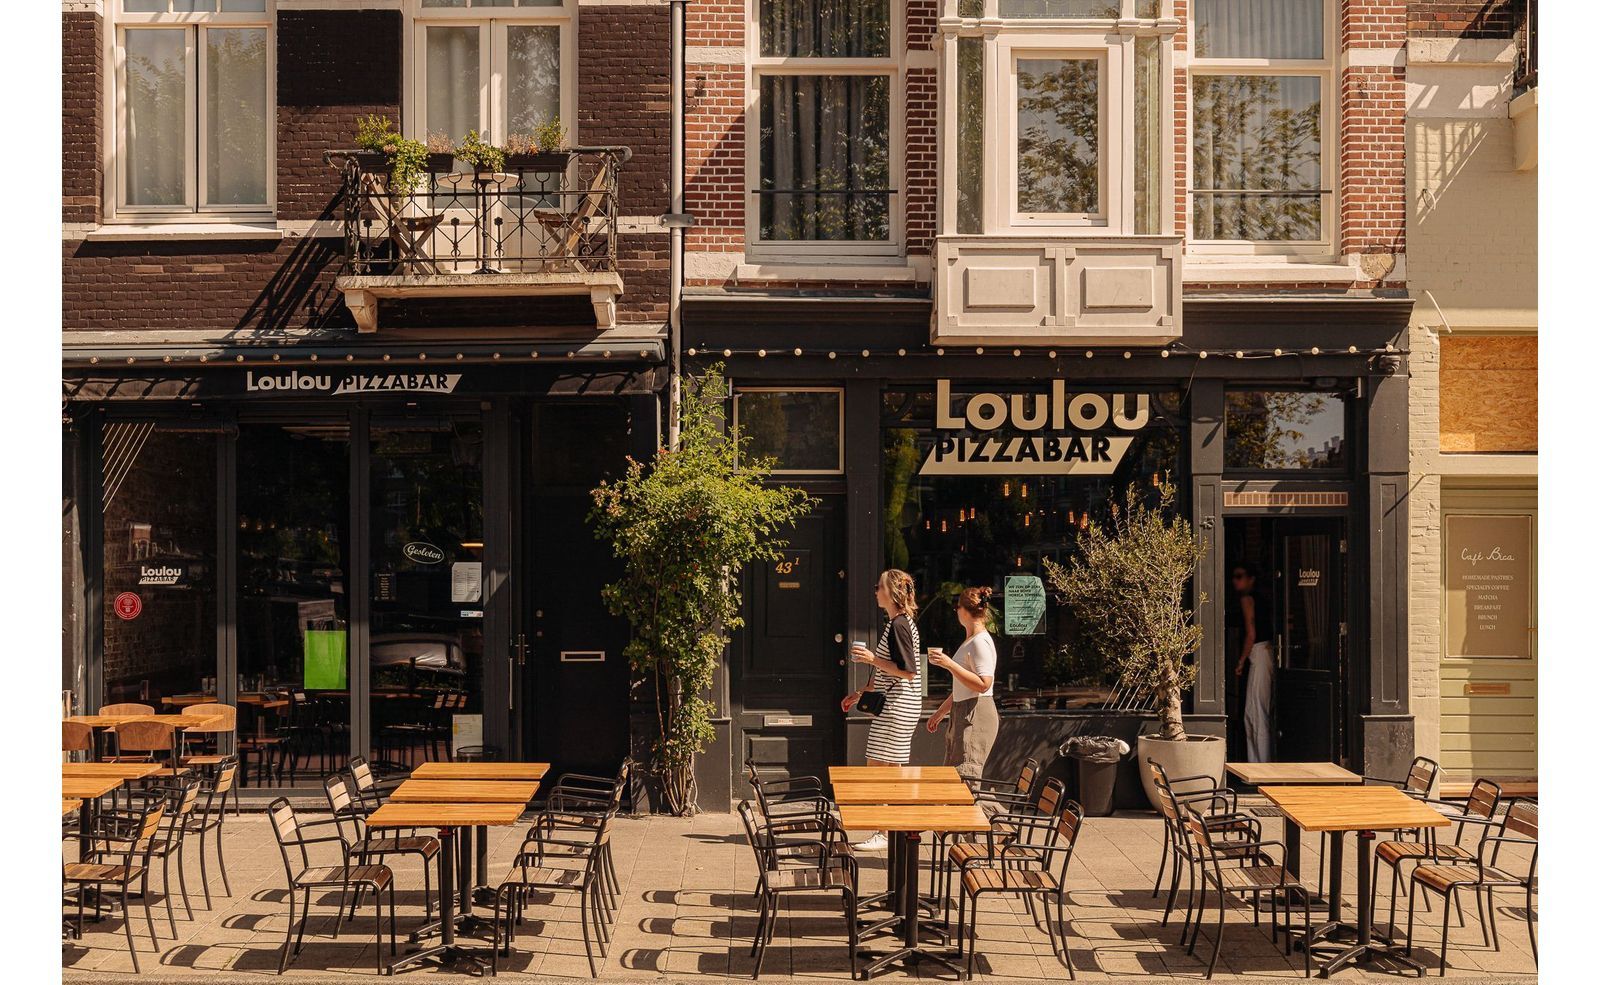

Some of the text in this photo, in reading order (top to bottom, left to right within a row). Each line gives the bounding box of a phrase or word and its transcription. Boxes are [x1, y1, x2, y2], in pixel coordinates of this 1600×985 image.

[247, 371, 449, 391] Loulou PIZZABAR
[936, 379, 1149, 430] Loulou
[932, 436, 1114, 464] PIZZABAR
[407, 545, 441, 559] Gesloten
[1461, 546, 1515, 566] Café Bica
[141, 566, 182, 577] Loulou
[775, 561, 793, 574] 43
[1299, 568, 1320, 578] Loulou
